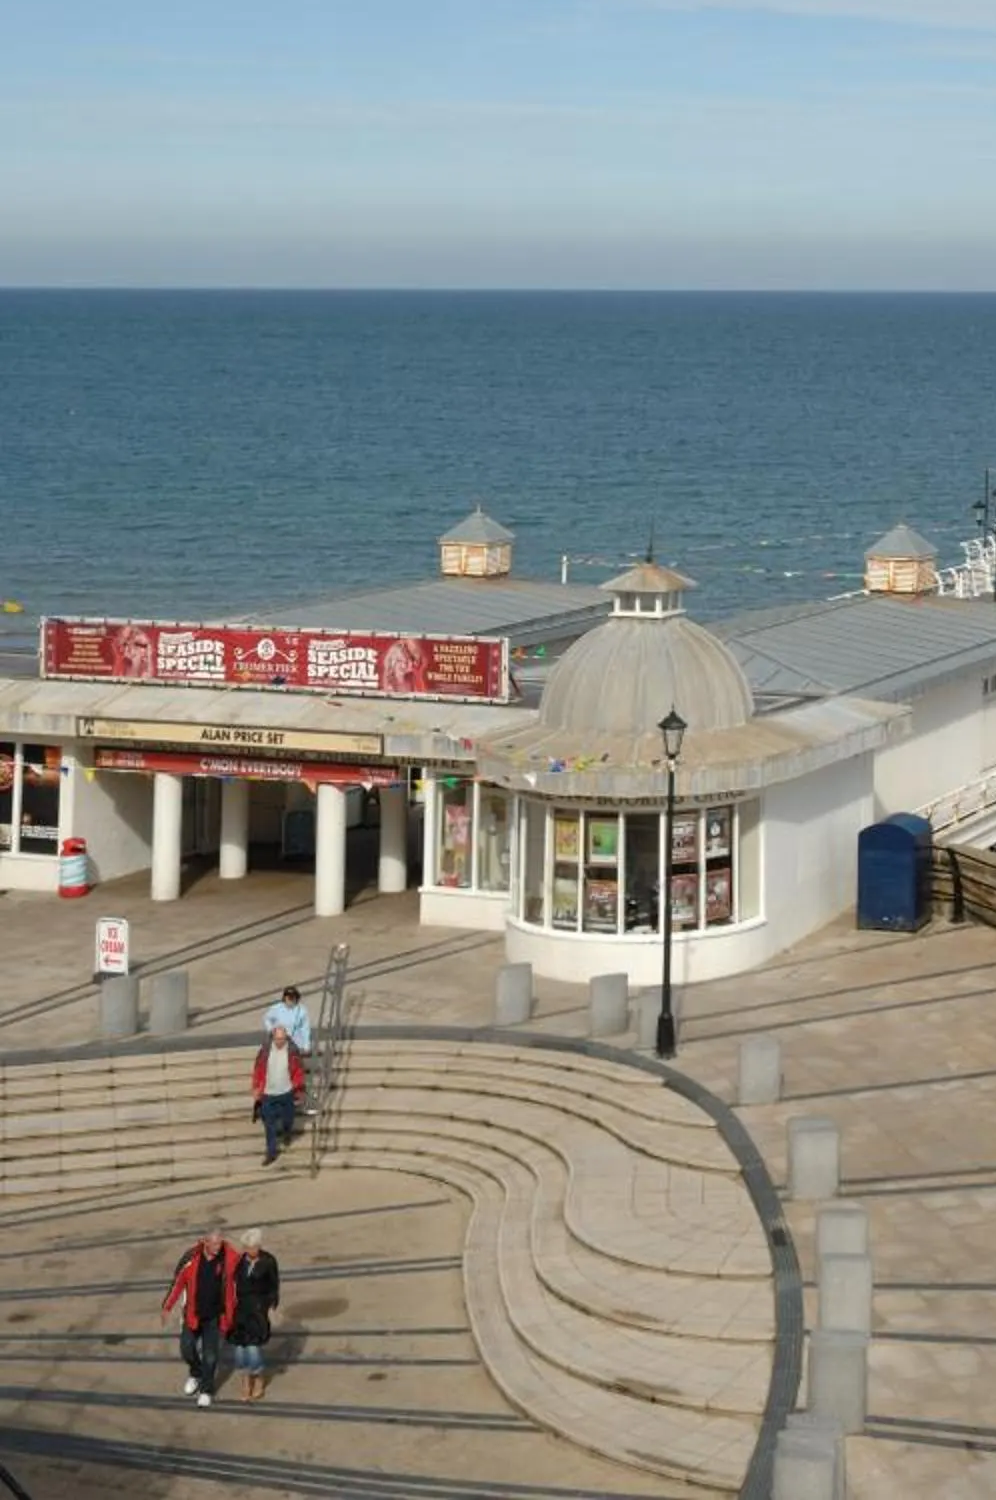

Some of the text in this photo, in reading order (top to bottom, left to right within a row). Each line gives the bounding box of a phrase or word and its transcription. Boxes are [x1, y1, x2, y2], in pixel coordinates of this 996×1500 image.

[157, 640, 224, 656] SEASIDE
[308, 647, 378, 665] SEASIDE
[308, 662, 379, 680] SPECIAL
[201, 728, 284, 744] ALAN PRICE SET
[200, 758, 302, 777] C'MON EVERYBODY
[107, 927, 119, 939] ICE
[100, 940, 125, 953] CREAM
